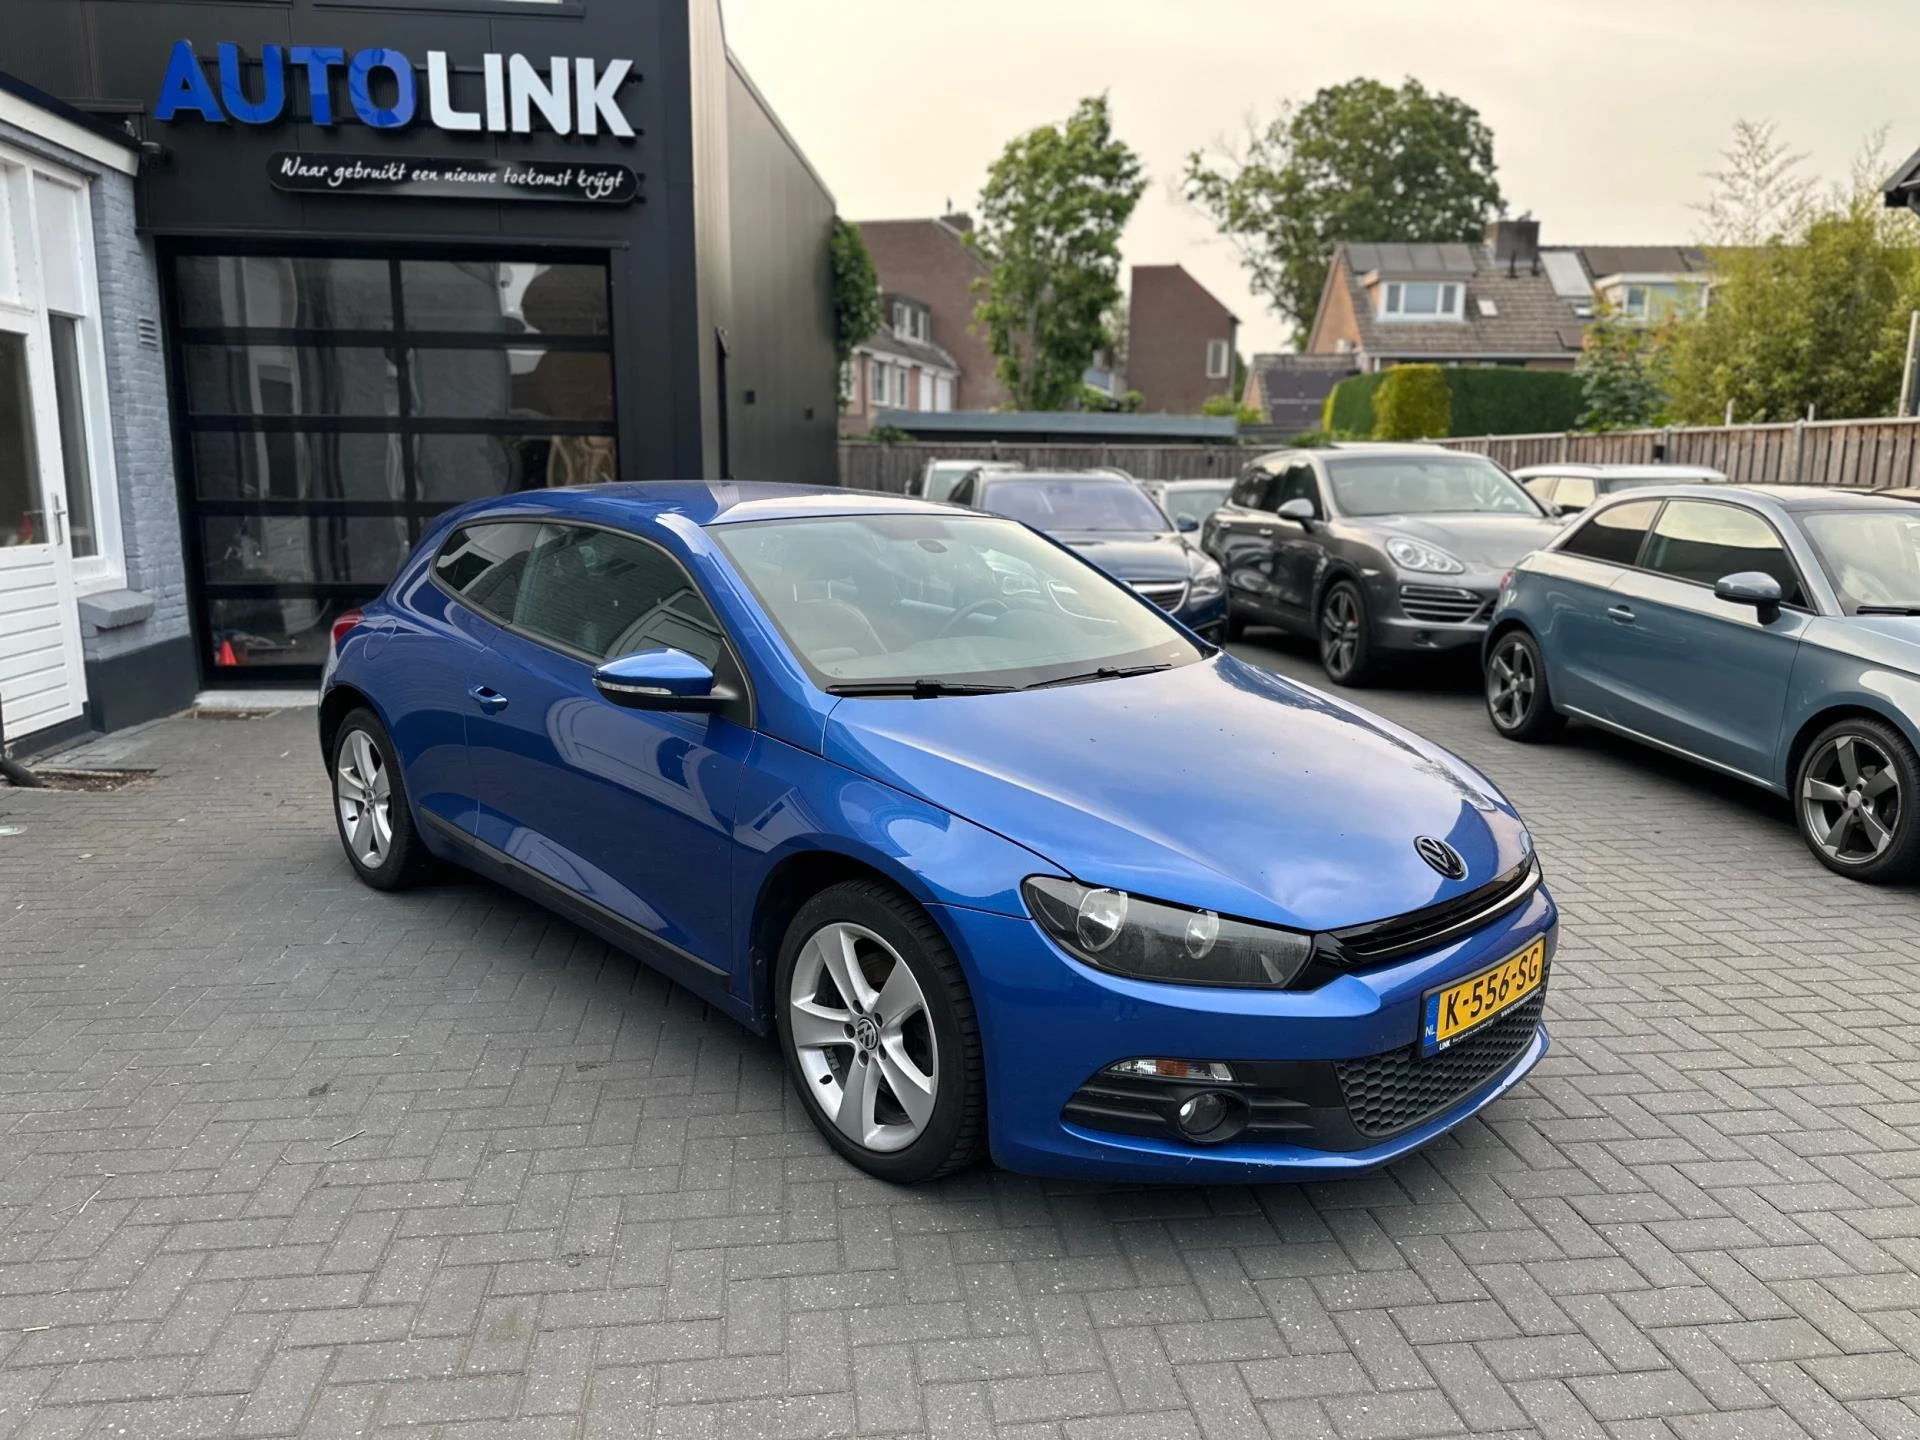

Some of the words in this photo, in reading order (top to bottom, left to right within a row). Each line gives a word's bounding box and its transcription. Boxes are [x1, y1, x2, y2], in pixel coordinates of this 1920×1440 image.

[280, 155, 329, 177] Waar
[327, 161, 407, 187] gebruikt
[411, 169, 439, 182] een
[444, 167, 497, 183] nieuwe
[503, 166, 573, 186] toekomst
[577, 168, 624, 199] krijgt
[1444, 946, 1539, 1031] K-556-SG
[1425, 1024, 1436, 1038] NL
